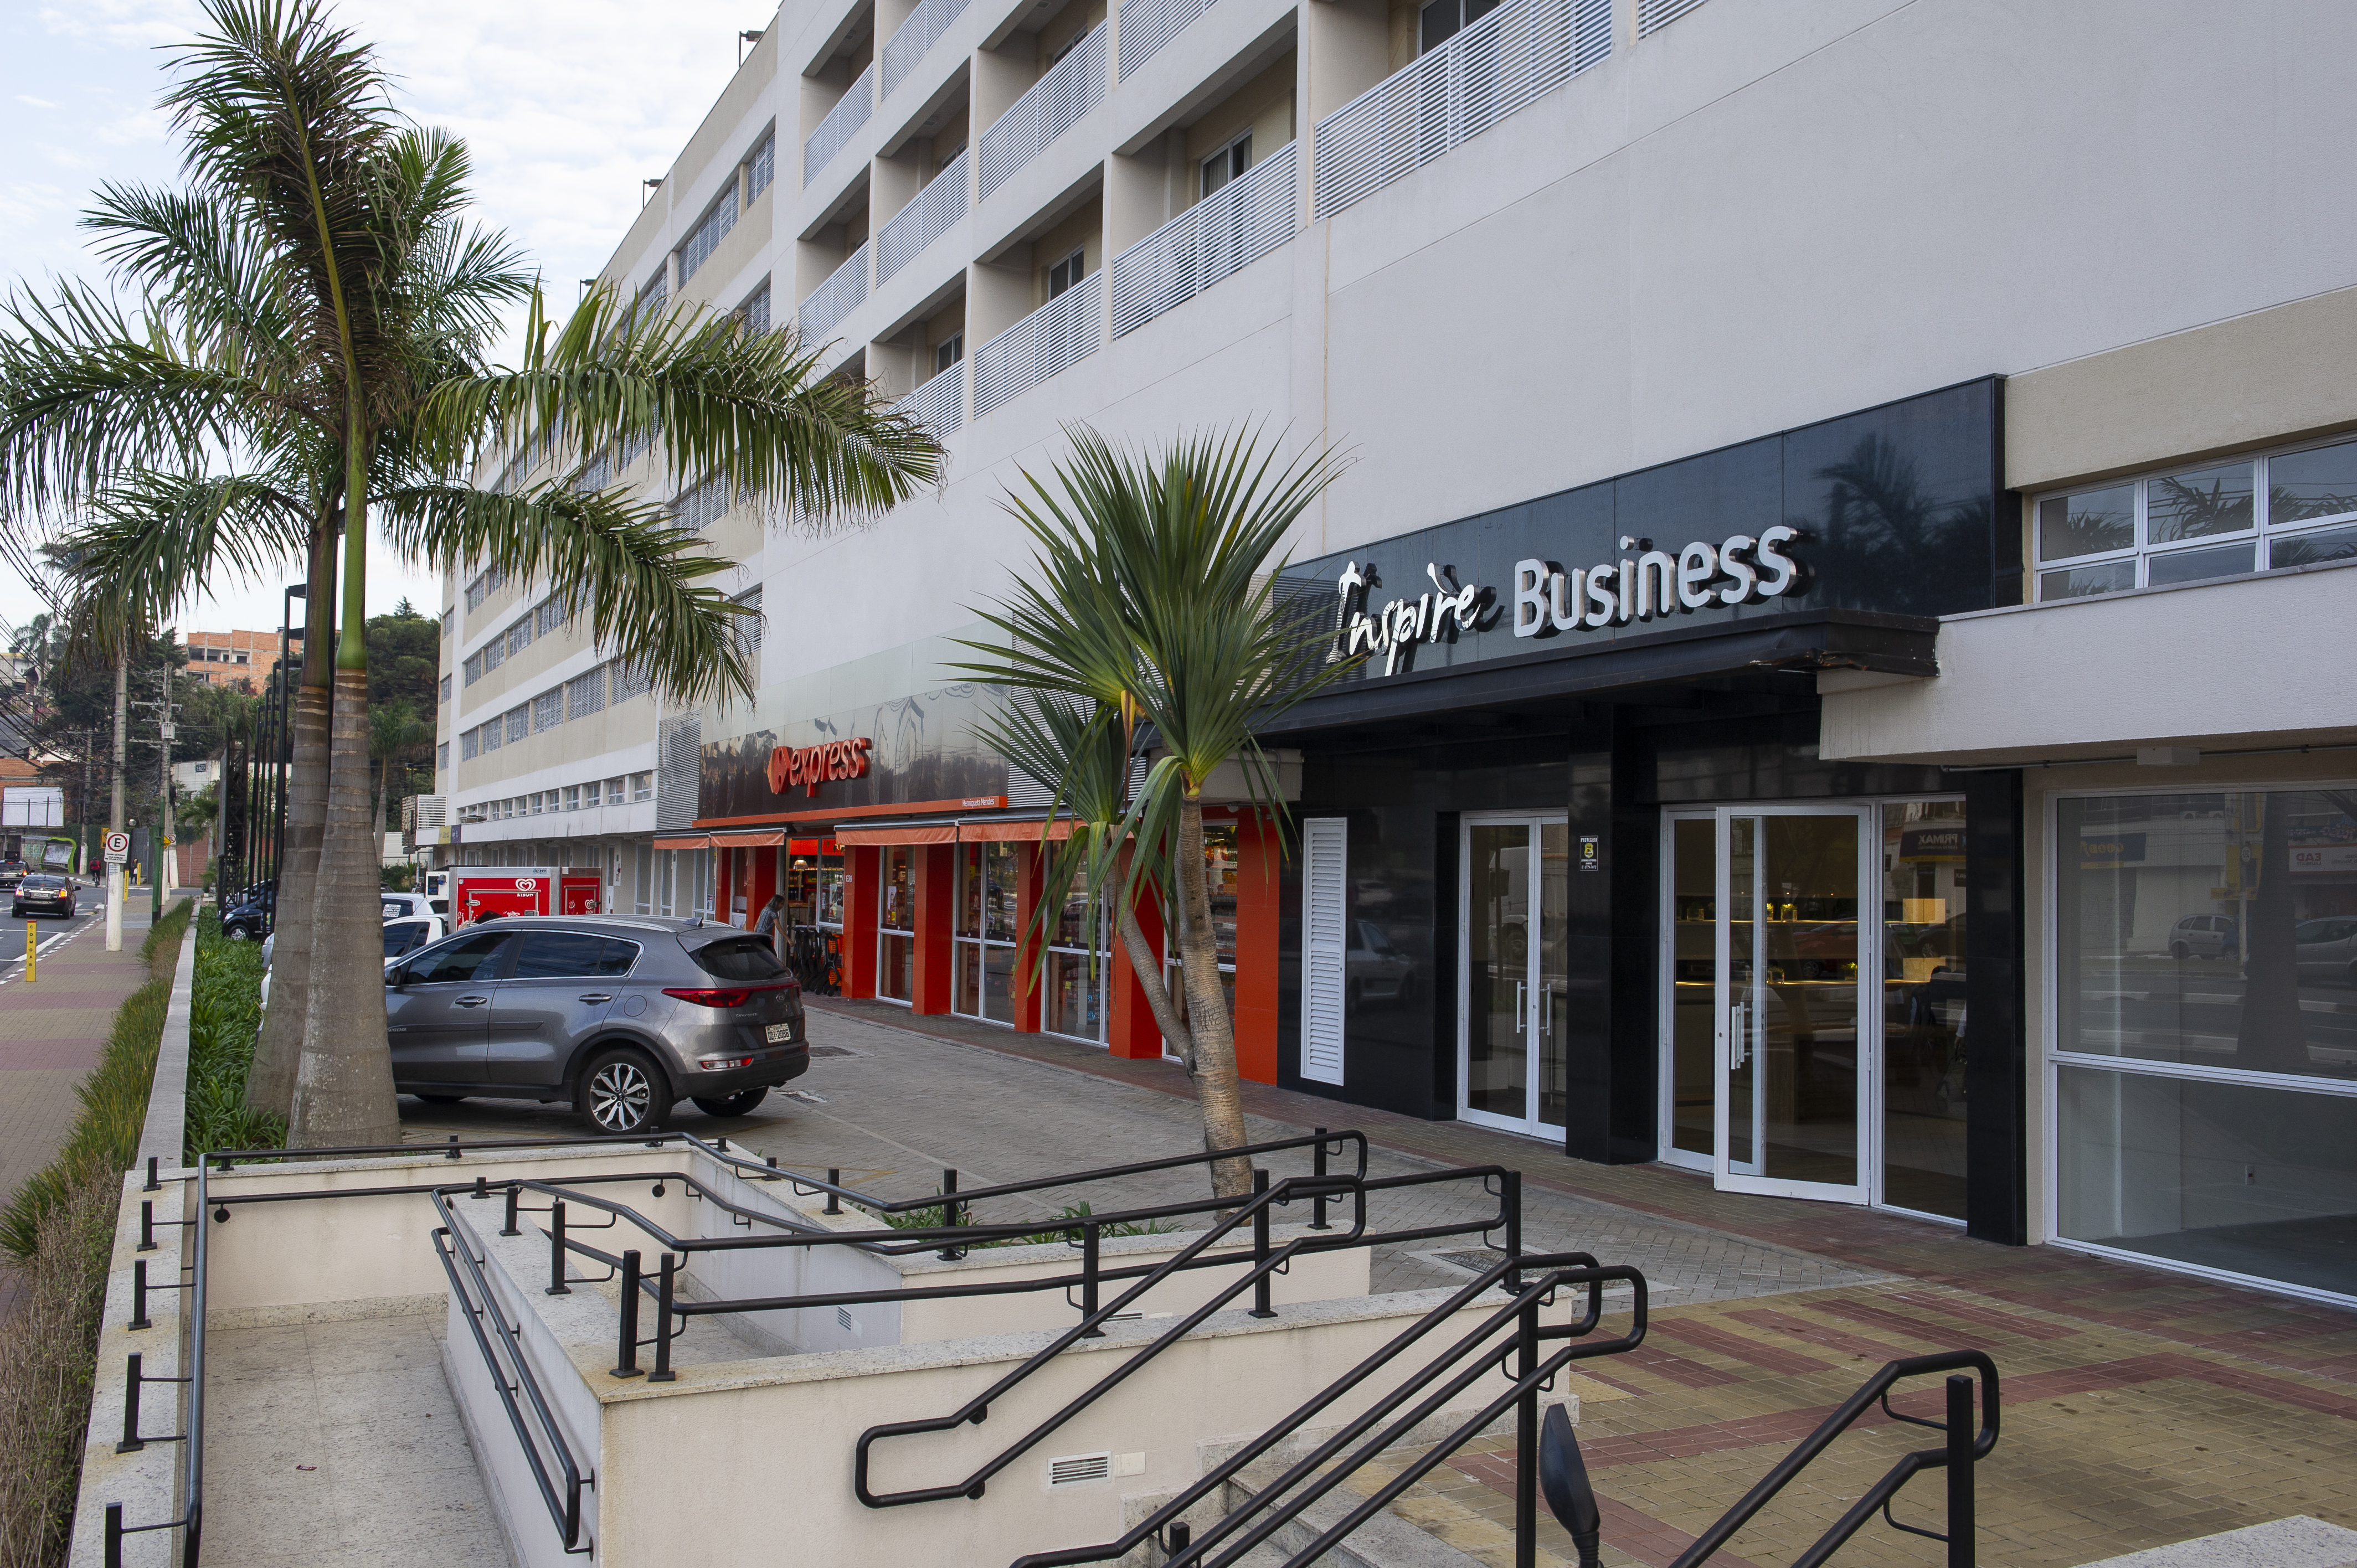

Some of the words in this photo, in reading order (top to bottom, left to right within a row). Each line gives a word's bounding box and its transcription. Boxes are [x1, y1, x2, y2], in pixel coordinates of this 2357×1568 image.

[1326, 560, 1483, 677] Inspire
[1514, 525, 1798, 638] Business
[790, 737, 867, 798] express
[981, 797, 995, 806] Mendes
[114, 838, 121, 847] E
